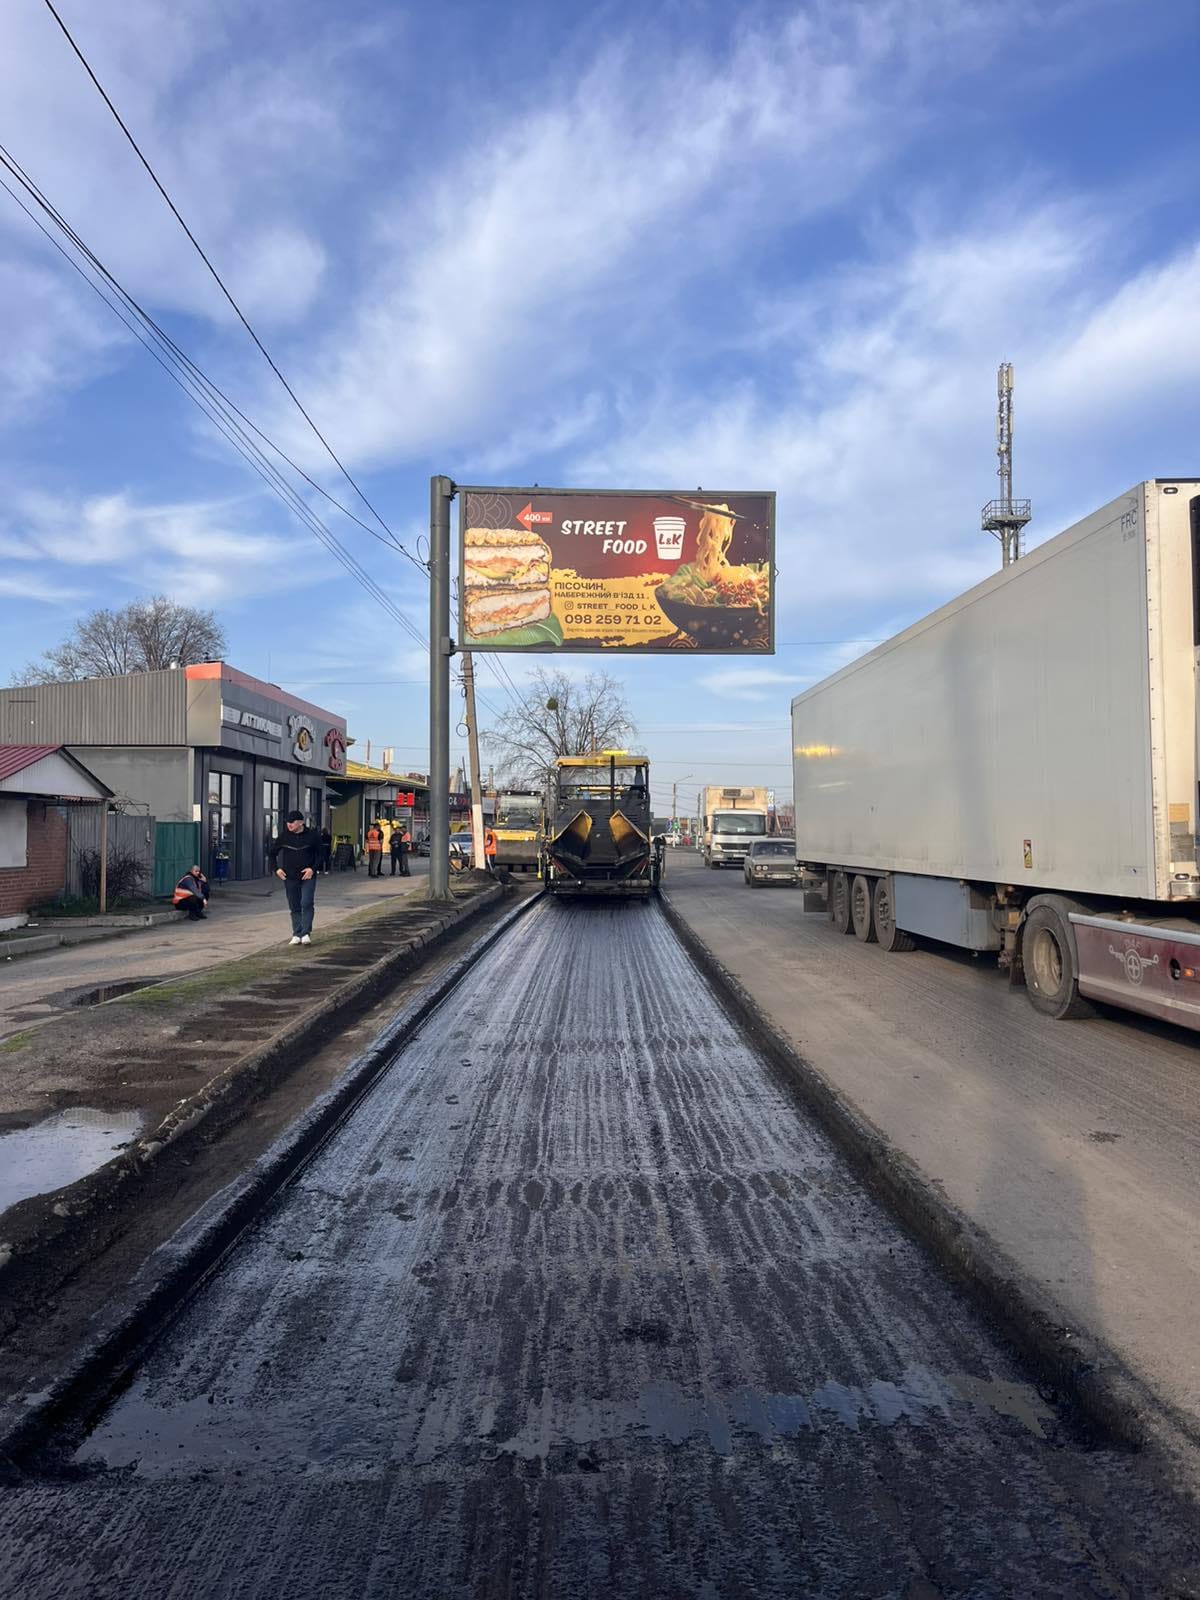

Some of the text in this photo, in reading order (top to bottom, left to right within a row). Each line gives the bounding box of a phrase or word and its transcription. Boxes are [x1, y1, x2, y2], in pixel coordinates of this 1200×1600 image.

[523, 513, 541, 522] 400
[560, 519, 627, 536] STREET
[658, 533, 682, 545] L&K
[602, 539, 647, 555] FOOD
[554, 582, 606, 591] ПІСОЧИН,
[554, 591, 611, 599] НАБЕРЕЖНИЙ
[564, 614, 661, 625] 098 259 71 02
